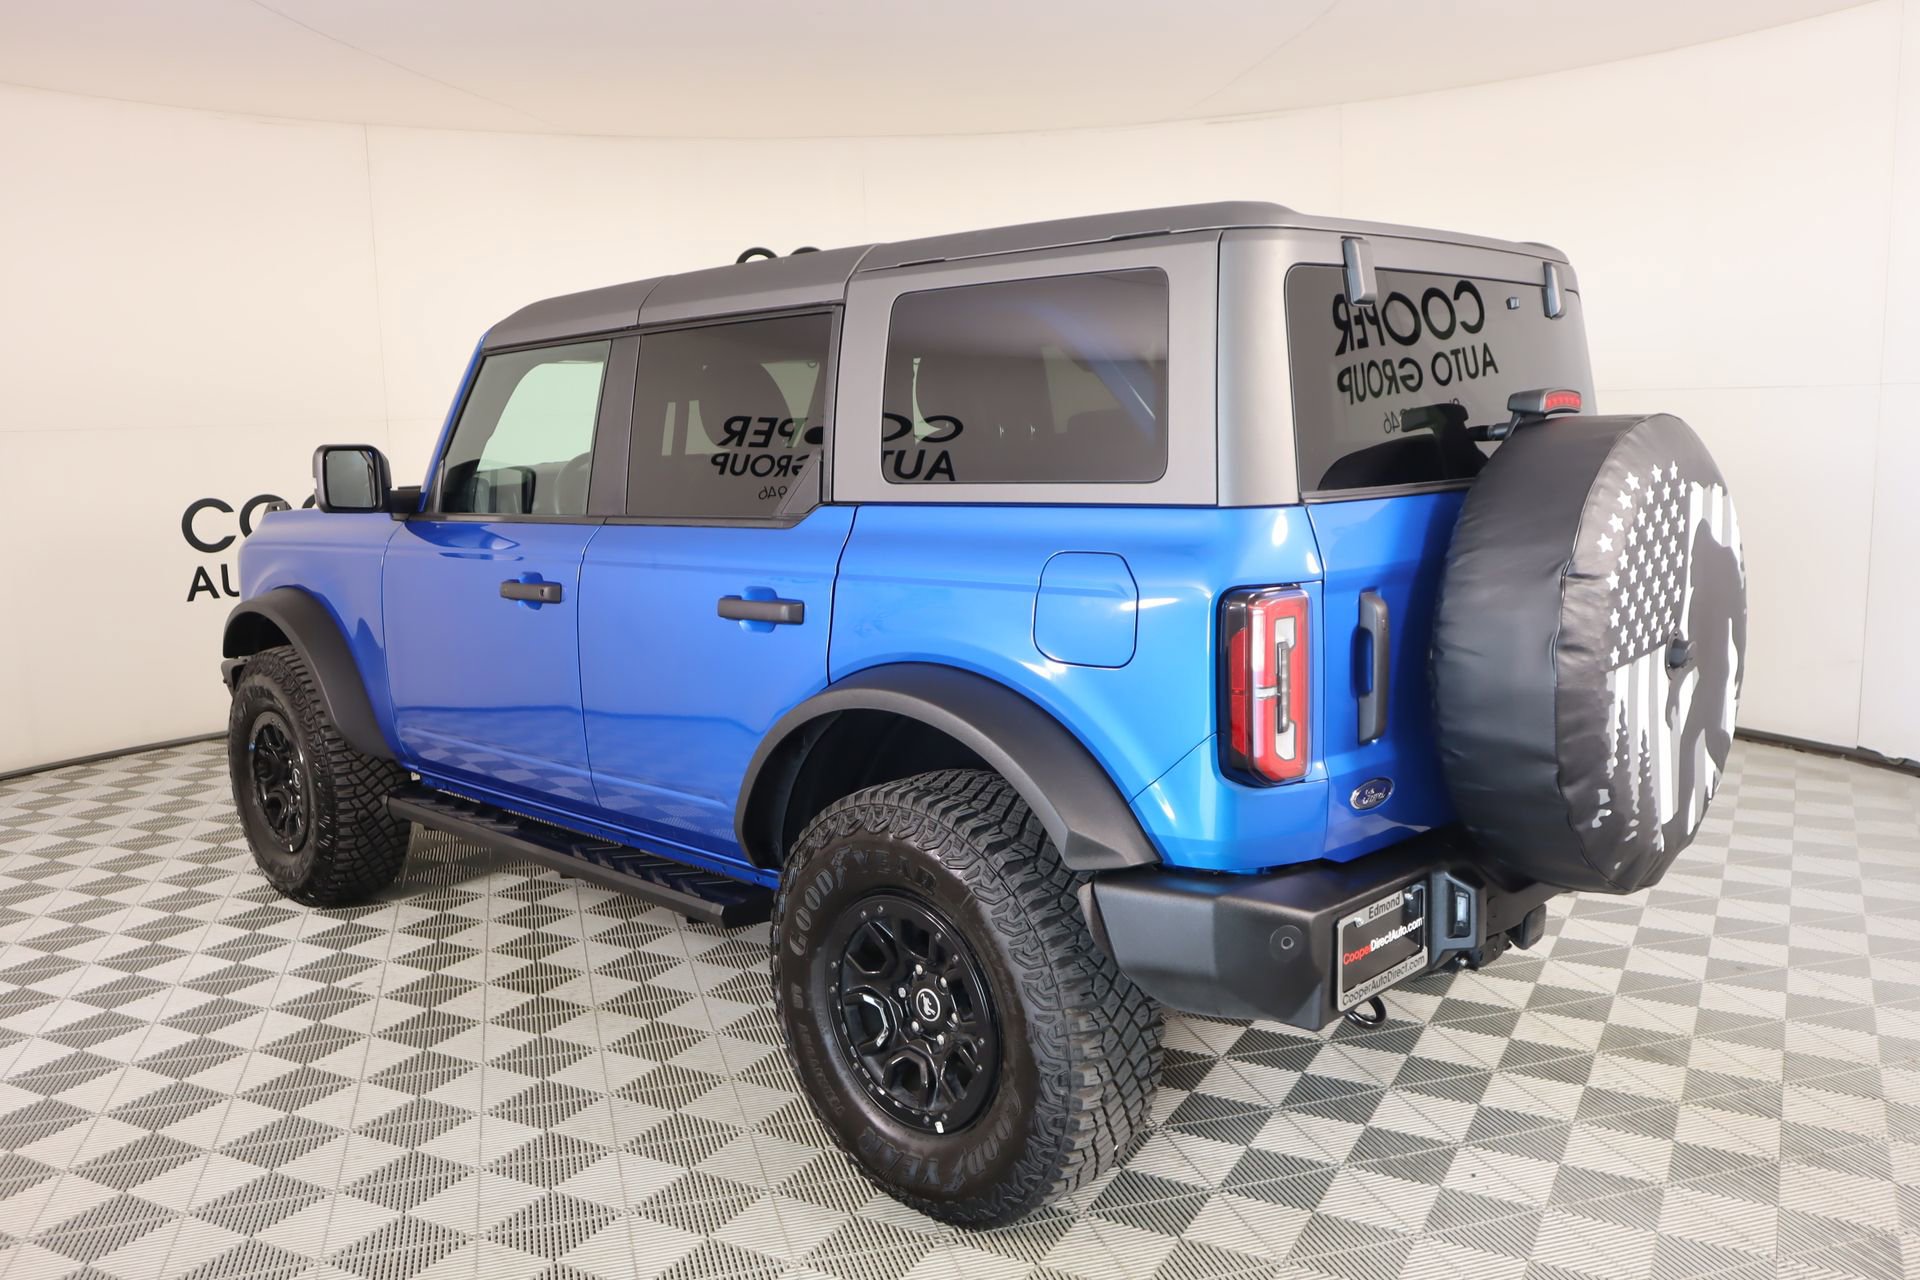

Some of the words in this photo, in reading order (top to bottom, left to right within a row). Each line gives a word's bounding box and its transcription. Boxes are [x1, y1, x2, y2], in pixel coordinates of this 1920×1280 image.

[1368, 894, 1401, 920] Edmond
[1343, 917, 1423, 966] CooperDirectAuto.com
[1342, 955, 1425, 1006] CooperAutoDirect.com
